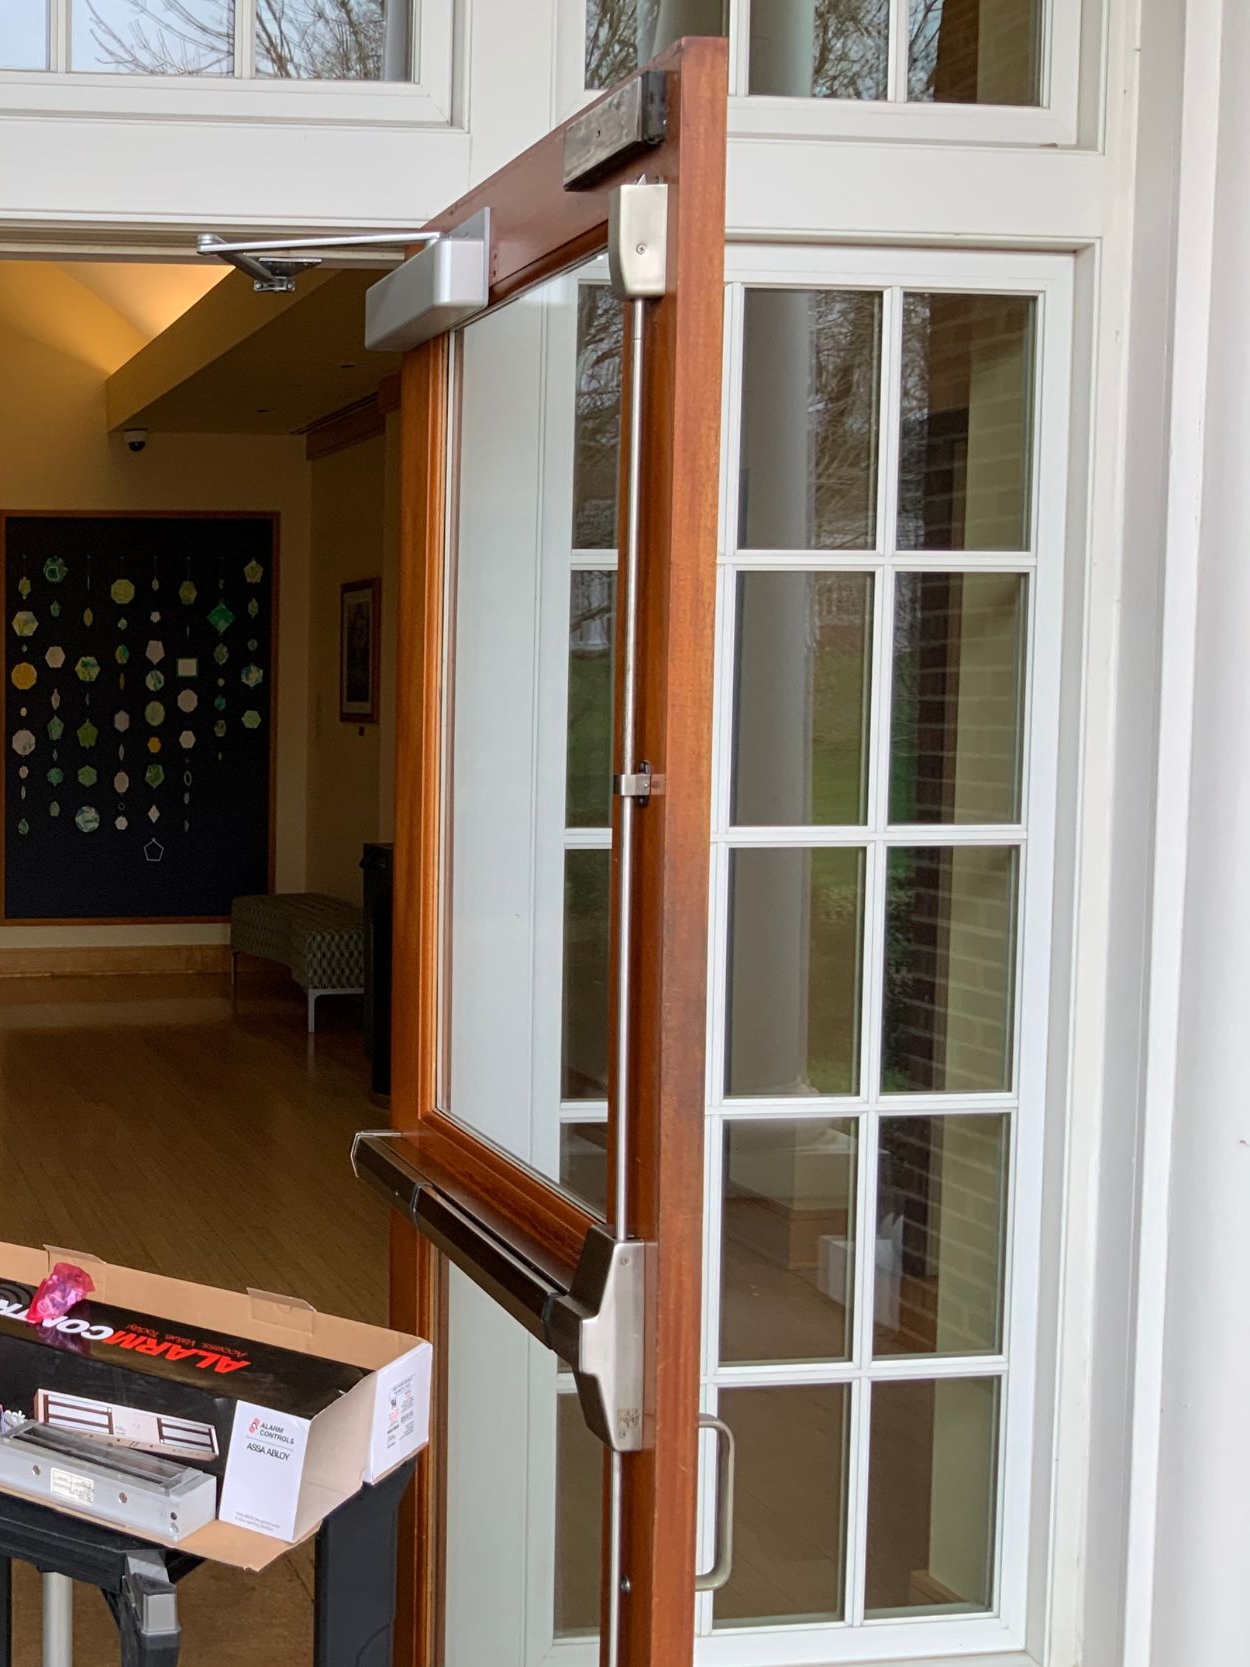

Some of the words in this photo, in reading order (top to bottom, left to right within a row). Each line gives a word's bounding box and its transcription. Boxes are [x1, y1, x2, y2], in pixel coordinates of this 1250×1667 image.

[260, 1422, 285, 1434] ALARM
[259, 1429, 295, 1445] CONTROLS
[246, 1442, 266, 1455] ASSA
[266, 1448, 290, 1461] ABLOY
